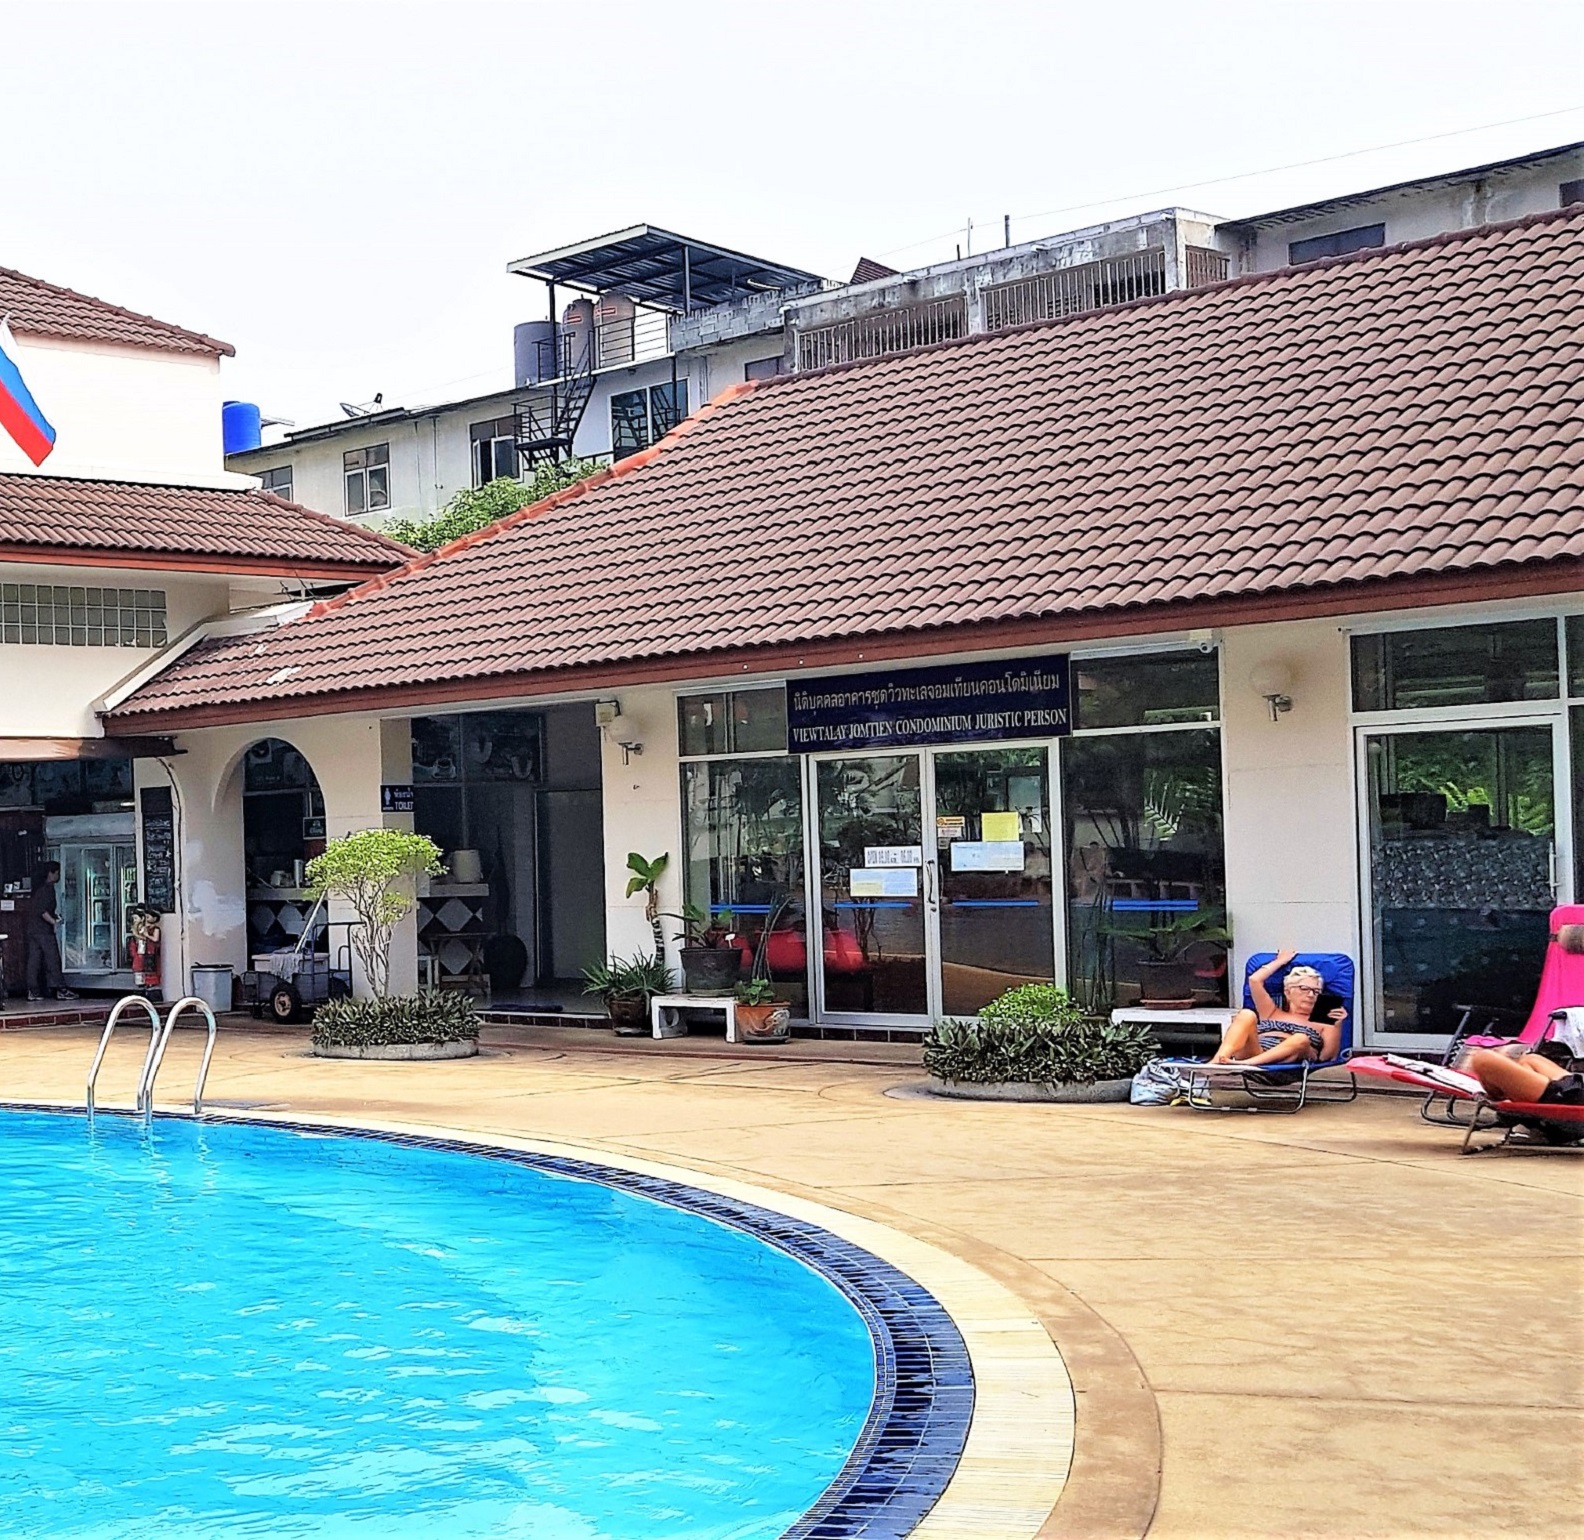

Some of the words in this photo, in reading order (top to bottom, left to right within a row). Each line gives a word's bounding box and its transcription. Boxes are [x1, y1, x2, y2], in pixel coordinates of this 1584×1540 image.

[793, 725, 848, 742] VIEWTALAY
[848, 720, 893, 739] JOMTIEN
[895, 714, 972, 735] CONDOMINIUM
[975, 710, 1022, 730] JURISTIC
[1023, 708, 1068, 727] PERSON
[394, 801, 414, 810] TOILET
